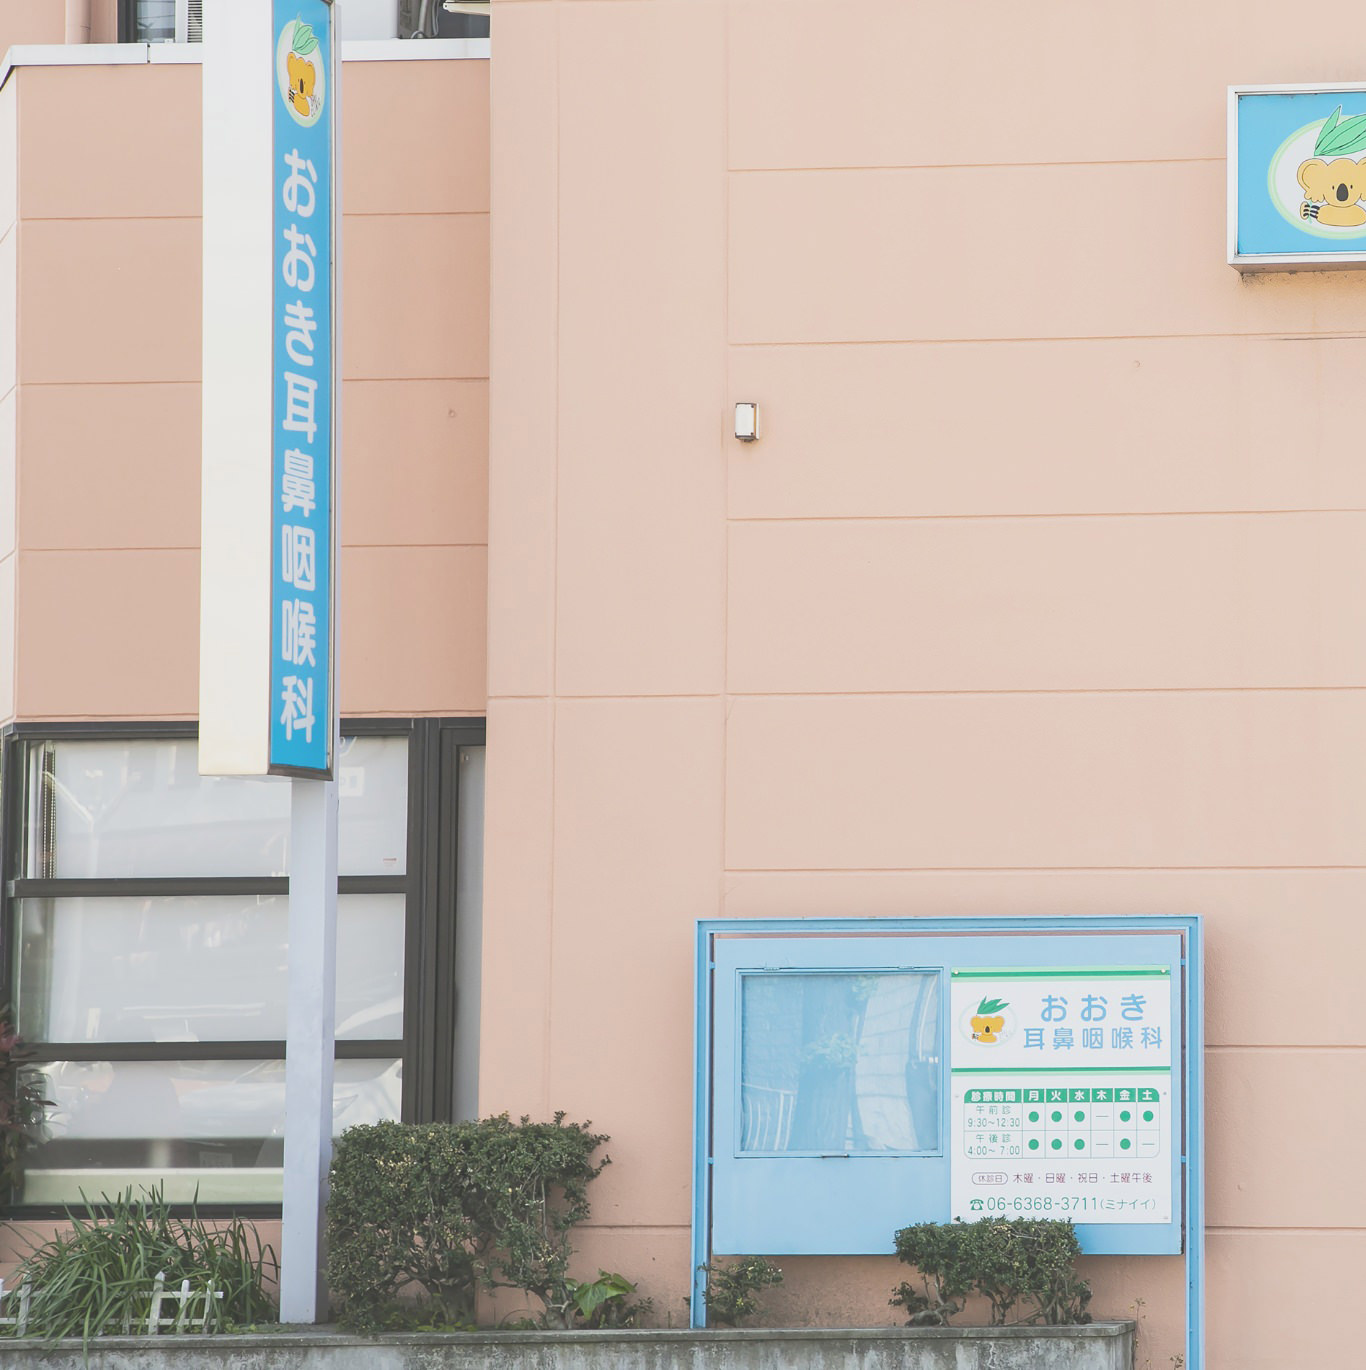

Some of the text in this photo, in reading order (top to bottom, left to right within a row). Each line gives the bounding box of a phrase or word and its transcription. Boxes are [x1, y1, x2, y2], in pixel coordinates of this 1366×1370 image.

[279, 148, 318, 743] おおき耳鼻咽喉科
[1040, 993, 1147, 1022] おおき
[1023, 1026, 1163, 1050] 耳鼻咽喉科
[971, 1089, 1153, 1102] 診療時間 月 火 水 木 金 土
[975, 1105, 1011, 1115] 午前診
[975, 1134, 1011, 1144] 午後診
[977, 1174, 1003, 1183] 休診日
